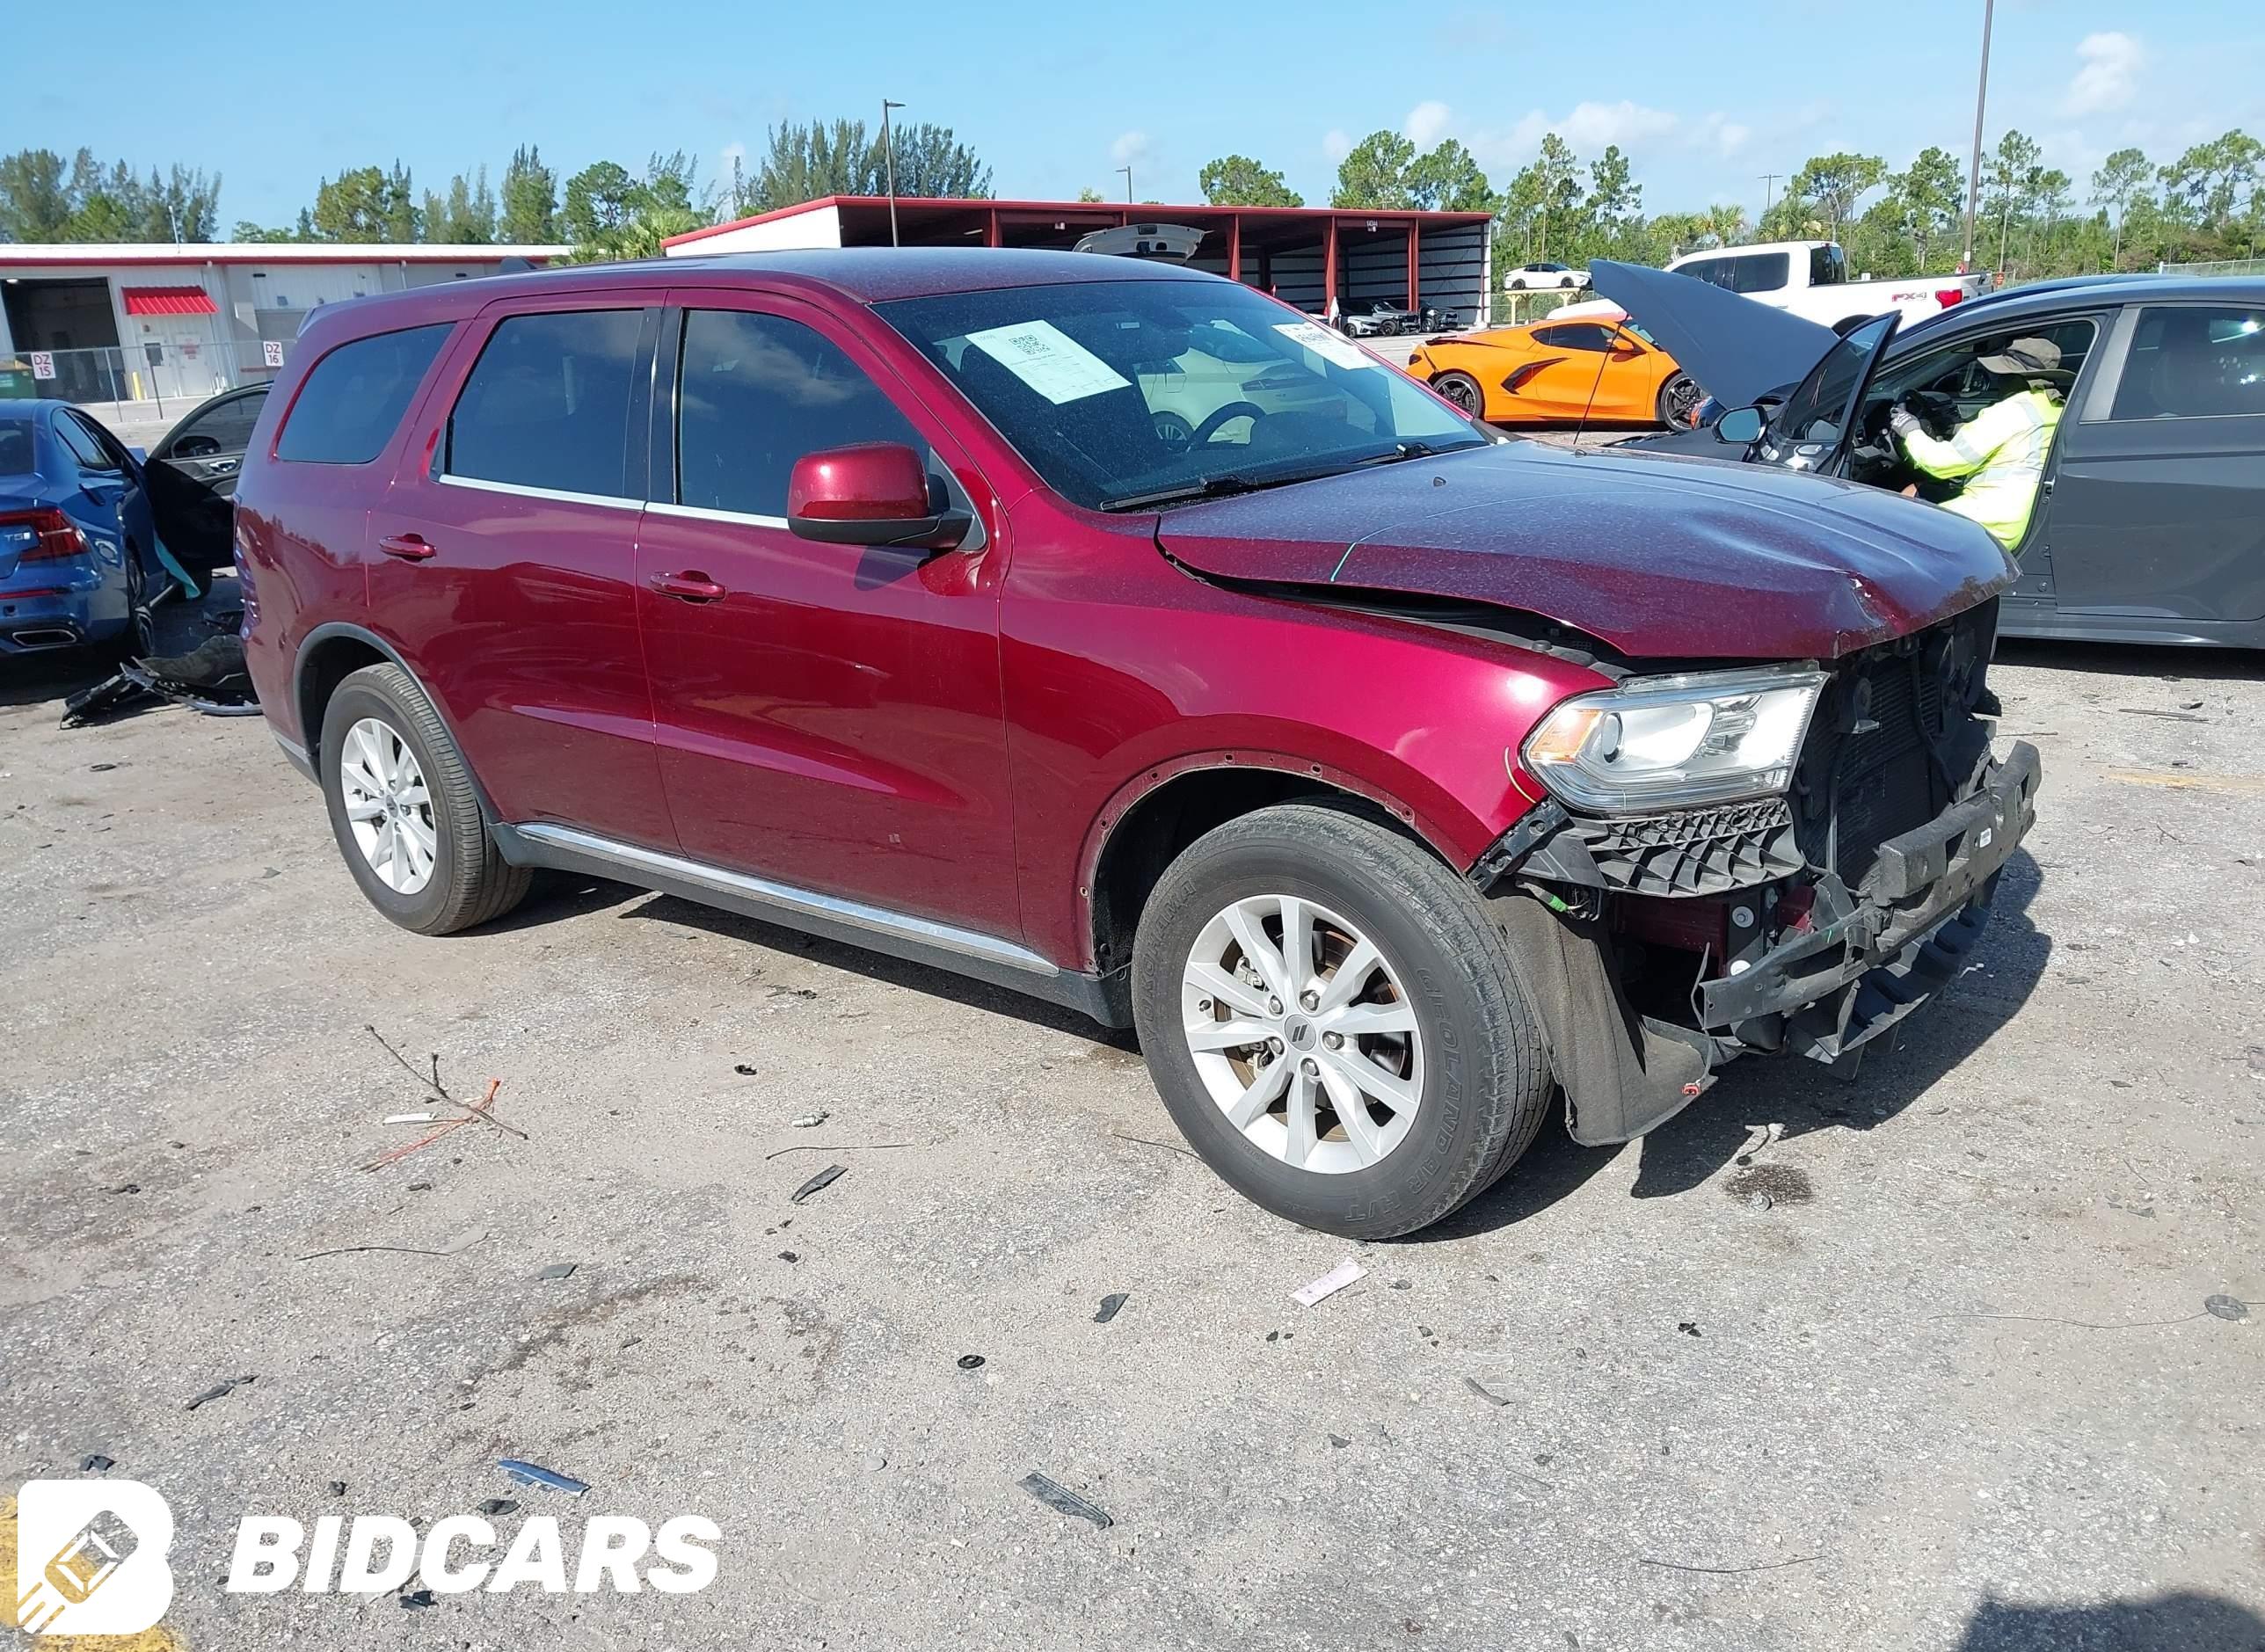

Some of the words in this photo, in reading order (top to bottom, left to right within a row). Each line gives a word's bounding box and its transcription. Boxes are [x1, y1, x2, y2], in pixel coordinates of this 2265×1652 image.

[1891, 292, 1926, 302] FX4
[266, 344, 280, 353] DZ
[33, 354, 51, 365] DZ
[269, 354, 279, 364] 16
[39, 366, 51, 376] 15
[1142, 879, 1197, 1044] YOKOHAMA
